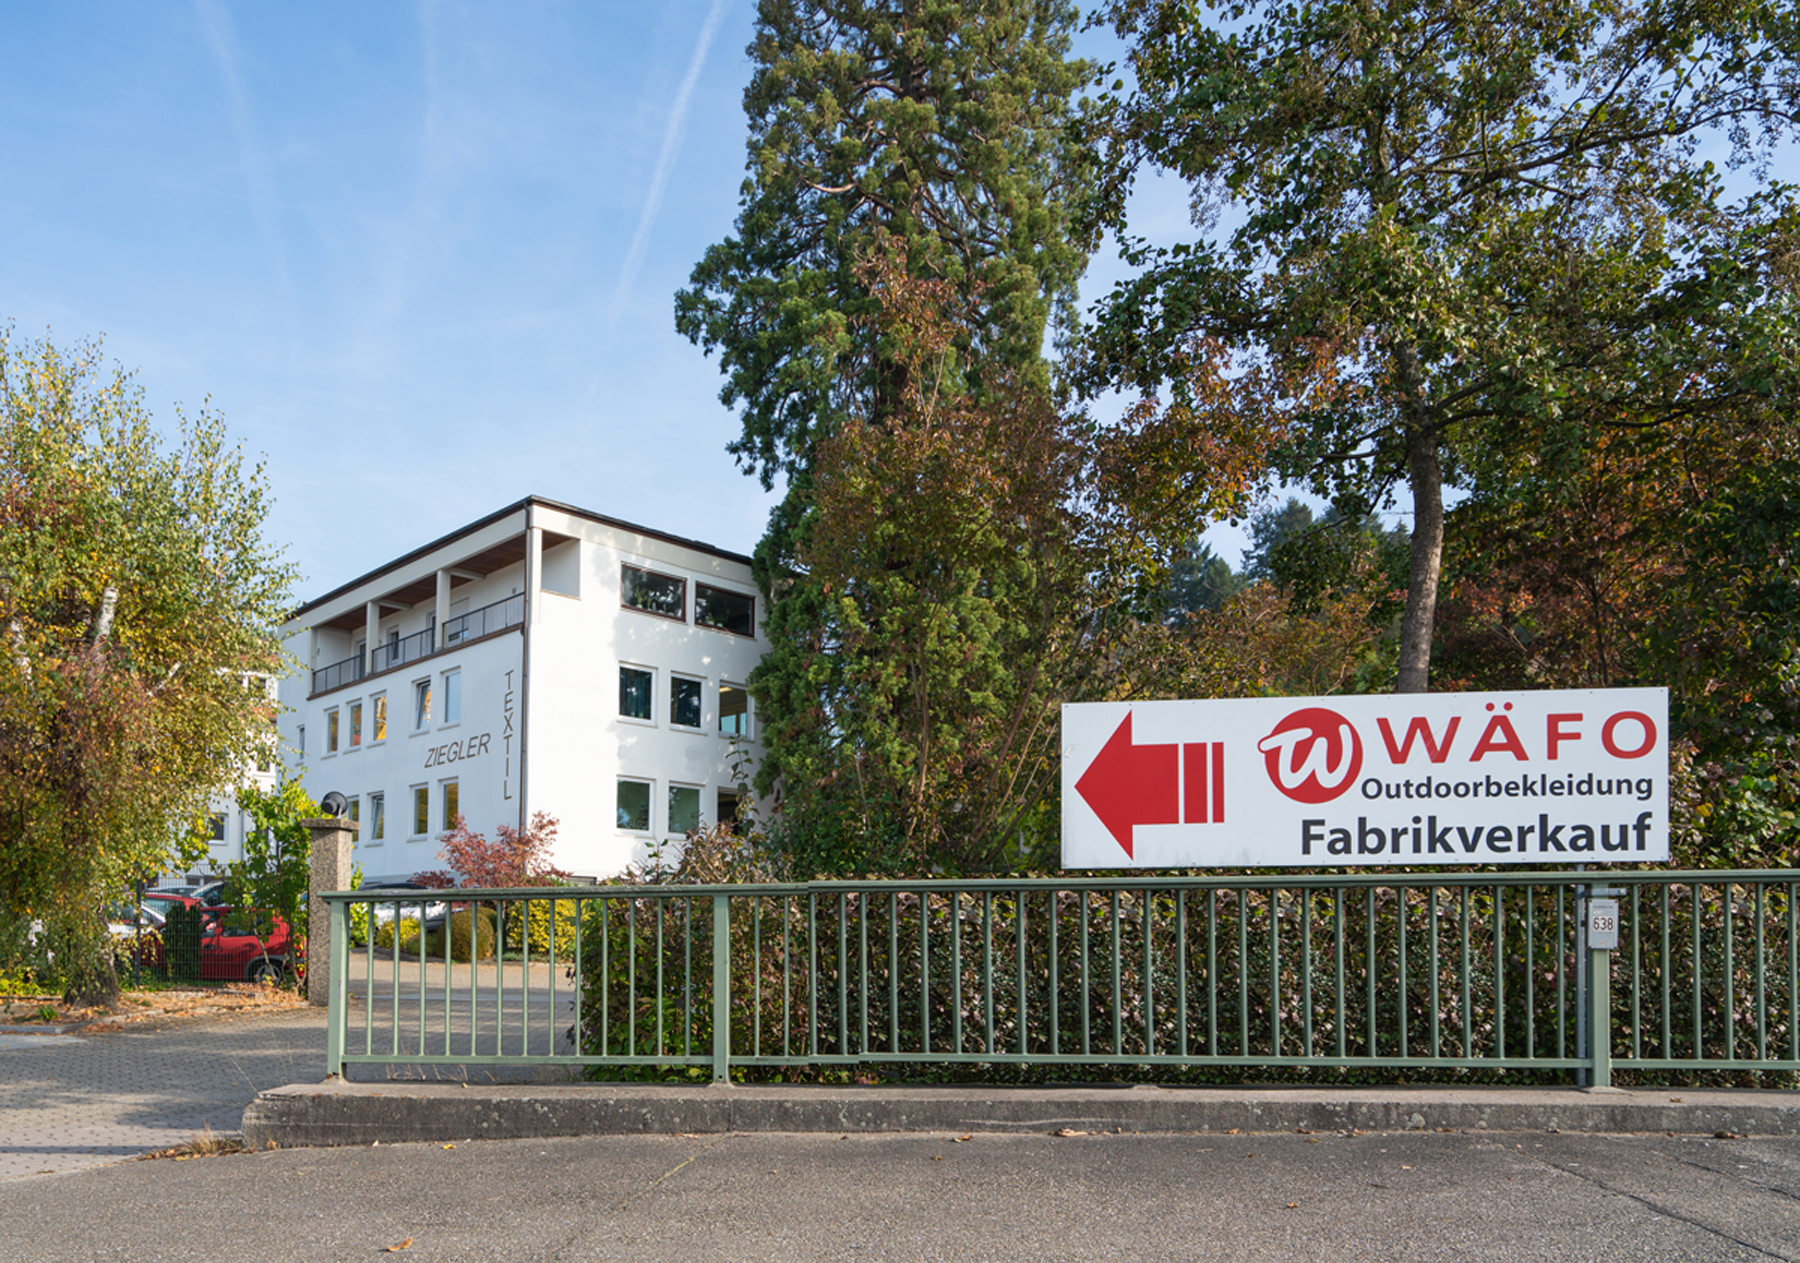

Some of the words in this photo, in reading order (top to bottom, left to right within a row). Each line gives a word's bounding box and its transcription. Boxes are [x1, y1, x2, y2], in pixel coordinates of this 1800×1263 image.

[424, 732, 491, 768] ZIEGLER
[503, 669, 514, 800] TEXTIL
[1376, 701, 1658, 764] WÄFO
[1361, 772, 1654, 801] Outdoorbekleidung
[1301, 811, 1652, 855] Fabrikverkauf
[1593, 917, 1613, 931] 638
